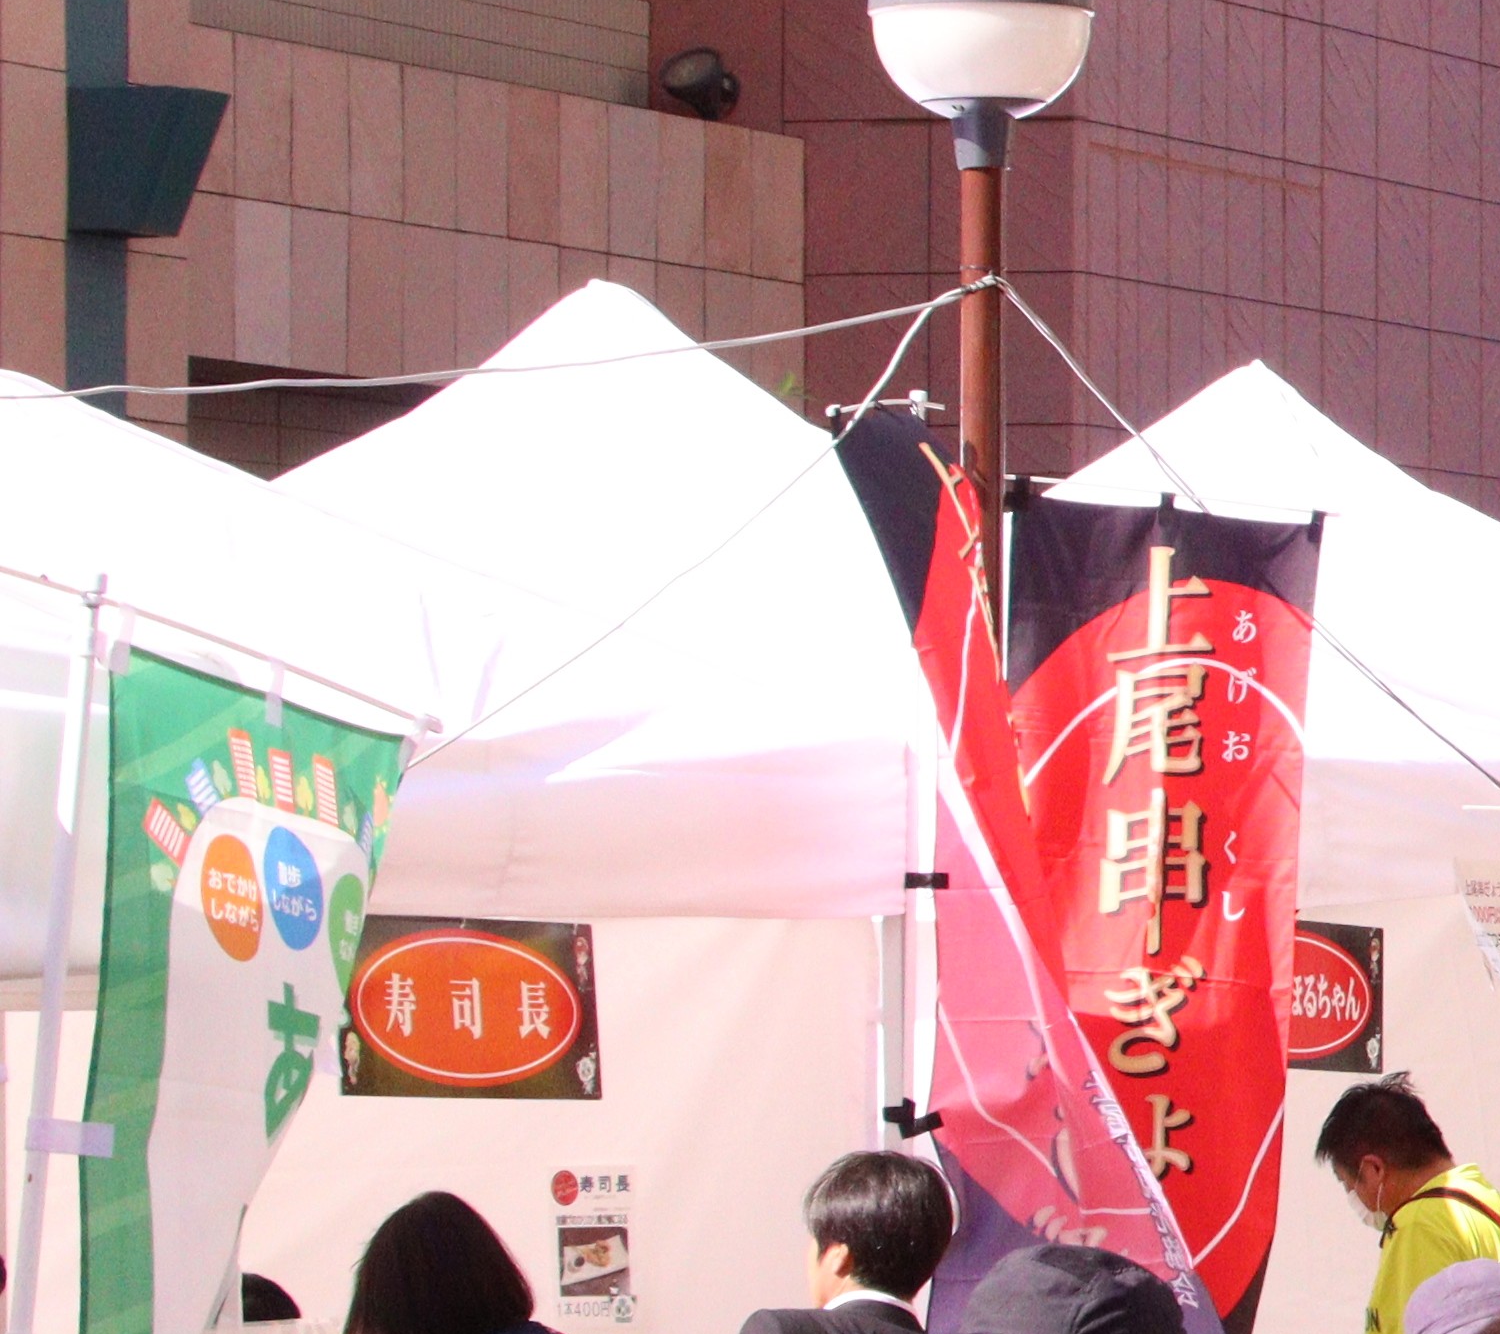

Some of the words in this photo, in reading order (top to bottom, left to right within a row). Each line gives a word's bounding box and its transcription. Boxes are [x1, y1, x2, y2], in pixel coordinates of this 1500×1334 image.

[207, 866, 258, 904] おでかけ
[209, 897, 261, 933] しながら
[384, 971, 551, 1041] 寿司長
[580, 1174, 631, 1194] 寿司長
